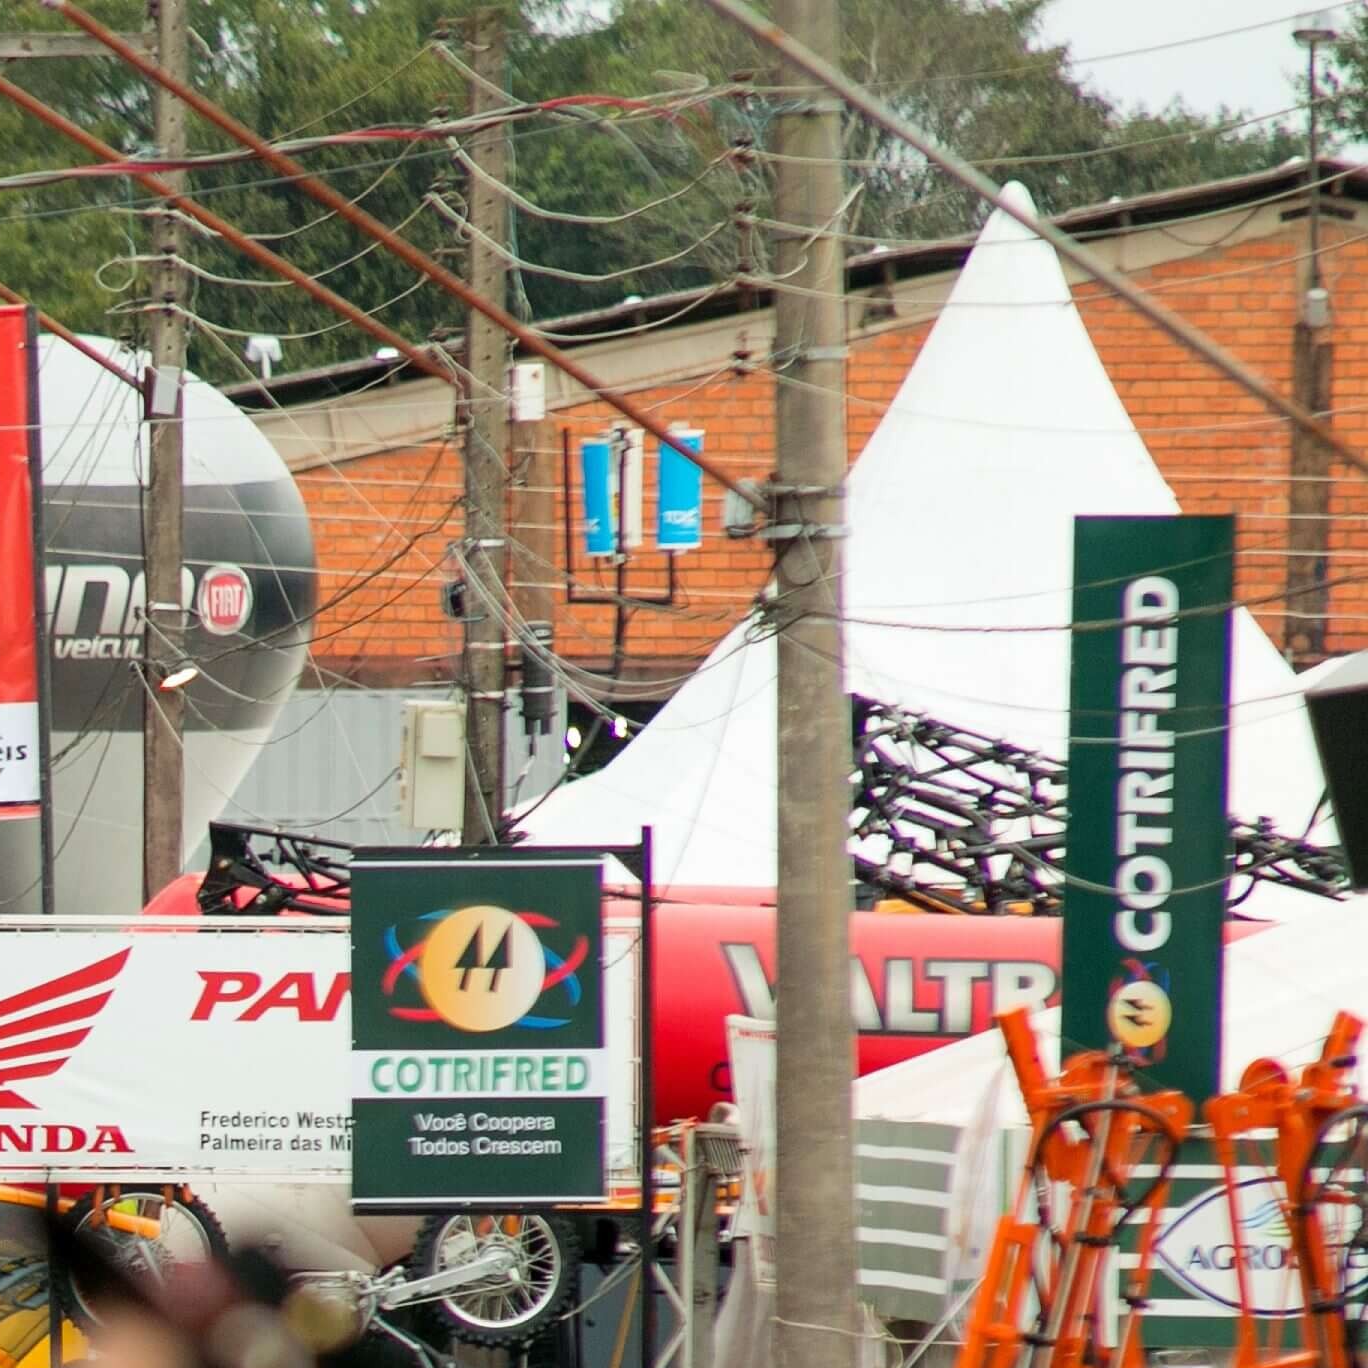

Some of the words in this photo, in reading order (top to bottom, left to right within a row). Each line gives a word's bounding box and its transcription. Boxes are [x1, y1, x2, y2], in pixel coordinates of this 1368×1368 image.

[210, 584, 242, 617] FIAT
[1113, 575, 1179, 952] COTRIFRED
[371, 1055, 590, 1093] COTRIFRED
[200, 1110, 290, 1128] Frederico
[415, 1112, 467, 1131] Você
[470, 1112, 556, 1134] Coopera
[200, 1134, 283, 1151] Palmeira
[290, 1134, 322, 1151] das
[330, 1134, 352, 1151] Mi
[407, 1136, 470, 1154] Todos
[471, 1136, 562, 1155] Crescem
